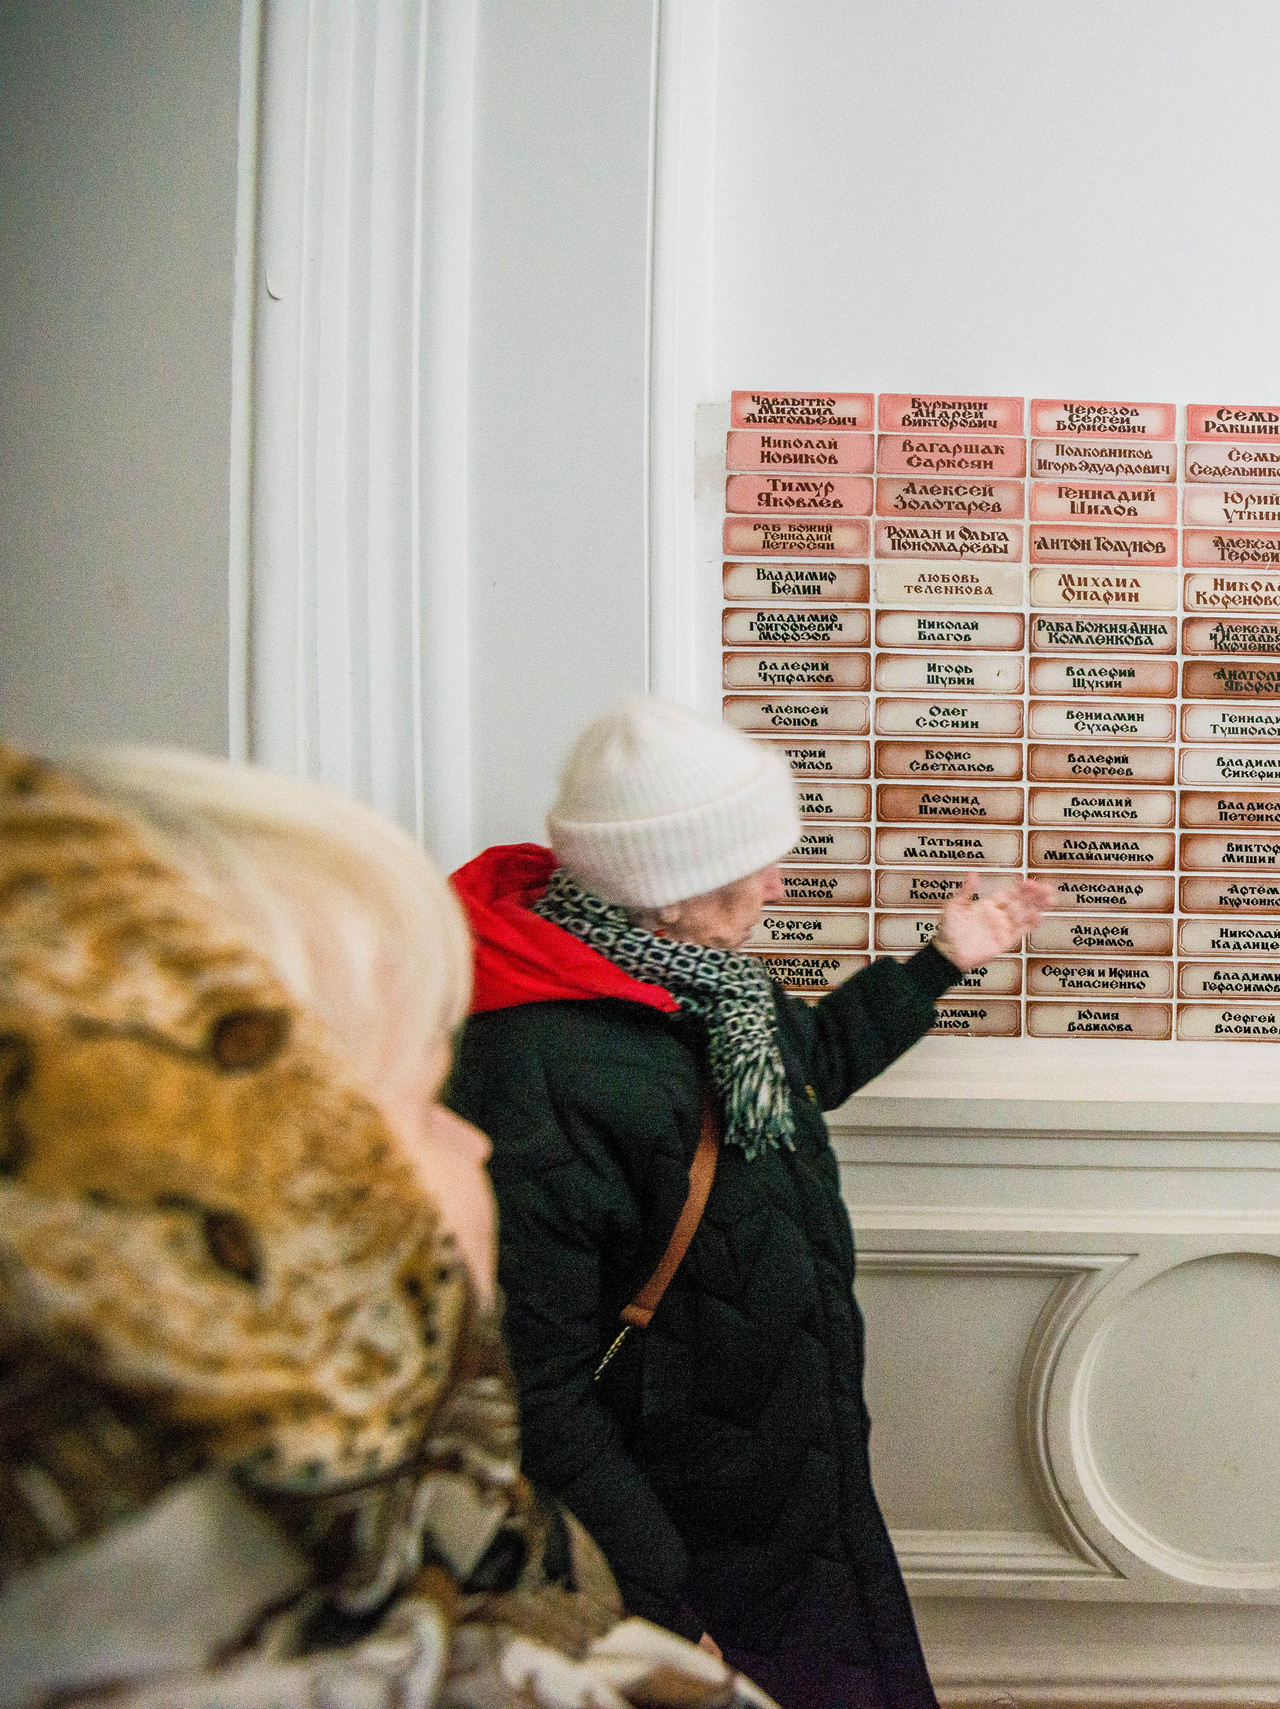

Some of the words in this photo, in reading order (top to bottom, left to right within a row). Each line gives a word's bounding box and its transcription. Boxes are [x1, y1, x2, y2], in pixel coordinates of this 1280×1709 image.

[758, 405, 834, 415] Михаил
[911, 397, 988, 411] Бурыкин
[1063, 404, 1139, 417] Черезов
[744, 413, 857, 426] Анатольевич
[912, 408, 984, 420] Андрей
[1068, 413, 1130, 425] Сергей
[901, 416, 997, 430] Викторович
[1056, 420, 1146, 434] Борисович
[761, 436, 838, 450] Николай
[902, 439, 1005, 457] Вагаршак
[760, 451, 838, 465] Новиков
[1055, 444, 1153, 460] Полковников
[767, 479, 835, 496] Тимур
[902, 482, 994, 497] Алексей
[758, 492, 843, 509] Яковлев
[1058, 486, 1155, 503] Геннадий
[1223, 491, 1280, 510] Юрий
[1070, 501, 1138, 517] Шилов
[764, 531, 831, 542] Геннадий
[885, 526, 942, 541] Роман
[945, 529, 955, 540] и
[959, 525, 1010, 541] Ольга
[762, 540, 834, 550] Петросян
[756, 568, 836, 584] Владимир
[1057, 573, 1141, 588] Михаил
[771, 582, 821, 595] Белин
[1061, 587, 1139, 605] Опарин
[757, 612, 838, 623] Владимир
[749, 621, 843, 632] Григорьевич
[917, 619, 979, 631] Николай
[1037, 619, 1074, 632] Раба
[1075, 621, 1127, 633] Божия
[1127, 622, 1168, 635] Анна
[759, 632, 830, 642] Морозов
[918, 630, 971, 642] Благов
[1048, 632, 1154, 646] Комленкова
[759, 660, 830, 673] Валерий
[927, 662, 973, 674] Игорь
[1066, 666, 1135, 680] Валерий
[758, 672, 834, 685] Чупраков
[927, 675, 975, 687] Шубин
[1072, 678, 1122, 691] Щукин
[762, 704, 828, 716] Алексей
[929, 705, 968, 717] Олег
[1066, 710, 1144, 723] Вениамин
[771, 715, 818, 727] Сопов
[915, 717, 979, 729] Соснин
[1074, 721, 1138, 735] Сухарев
[926, 750, 971, 762] Борис
[1068, 753, 1129, 765] Валерий
[909, 760, 994, 772] Светлаков
[1072, 765, 1133, 777] Сергеев
[922, 793, 979, 806] Леонид
[1071, 797, 1132, 808] Василий
[919, 804, 987, 817] Пименов
[1063, 807, 1138, 821] Пермяков
[918, 836, 983, 848] Татьяна
[1063, 840, 1140, 852] Людмила
[1227, 842, 1280, 855] Виктор
[904, 848, 985, 860] Мальцева
[1044, 850, 1154, 863] Михайличенко
[1222, 853, 1276, 864] Мишин
[1058, 883, 1144, 896] Александр
[1076, 894, 1127, 905] Коняев
[763, 918, 822, 931] Сергей
[1071, 924, 1129, 938] Андрей
[771, 930, 814, 941] Ежов
[1059, 978, 1146, 990] Танасиенко
[1078, 1009, 1120, 1021] Юлия
[1222, 1012, 1276, 1024] Сергей
[1067, 1020, 1133, 1032] Вавилова
